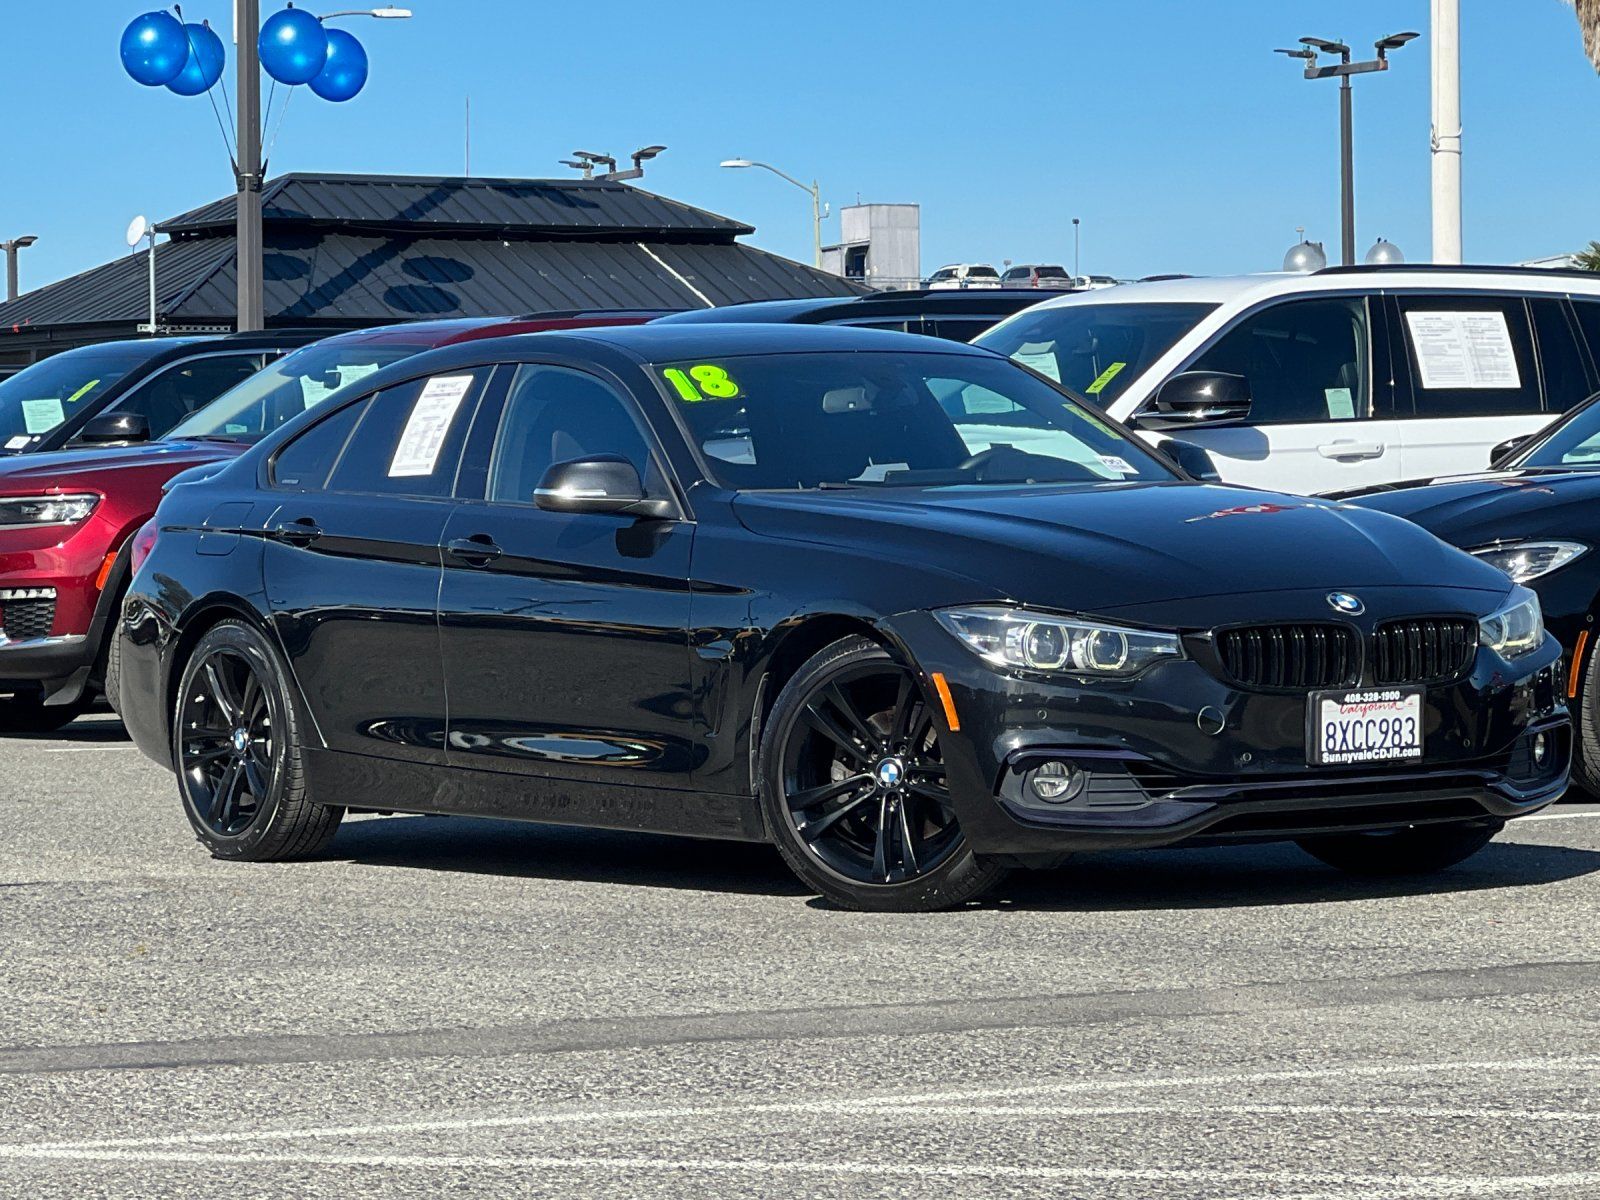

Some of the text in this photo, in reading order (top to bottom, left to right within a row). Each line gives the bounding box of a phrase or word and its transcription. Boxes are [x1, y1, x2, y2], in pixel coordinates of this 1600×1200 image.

[664, 365, 738, 401] 18
[1340, 701, 1403, 718] California
[1325, 717, 1415, 751] 8XCC983
[1322, 748, 1420, 763] SunnyvaleCDJR.com
